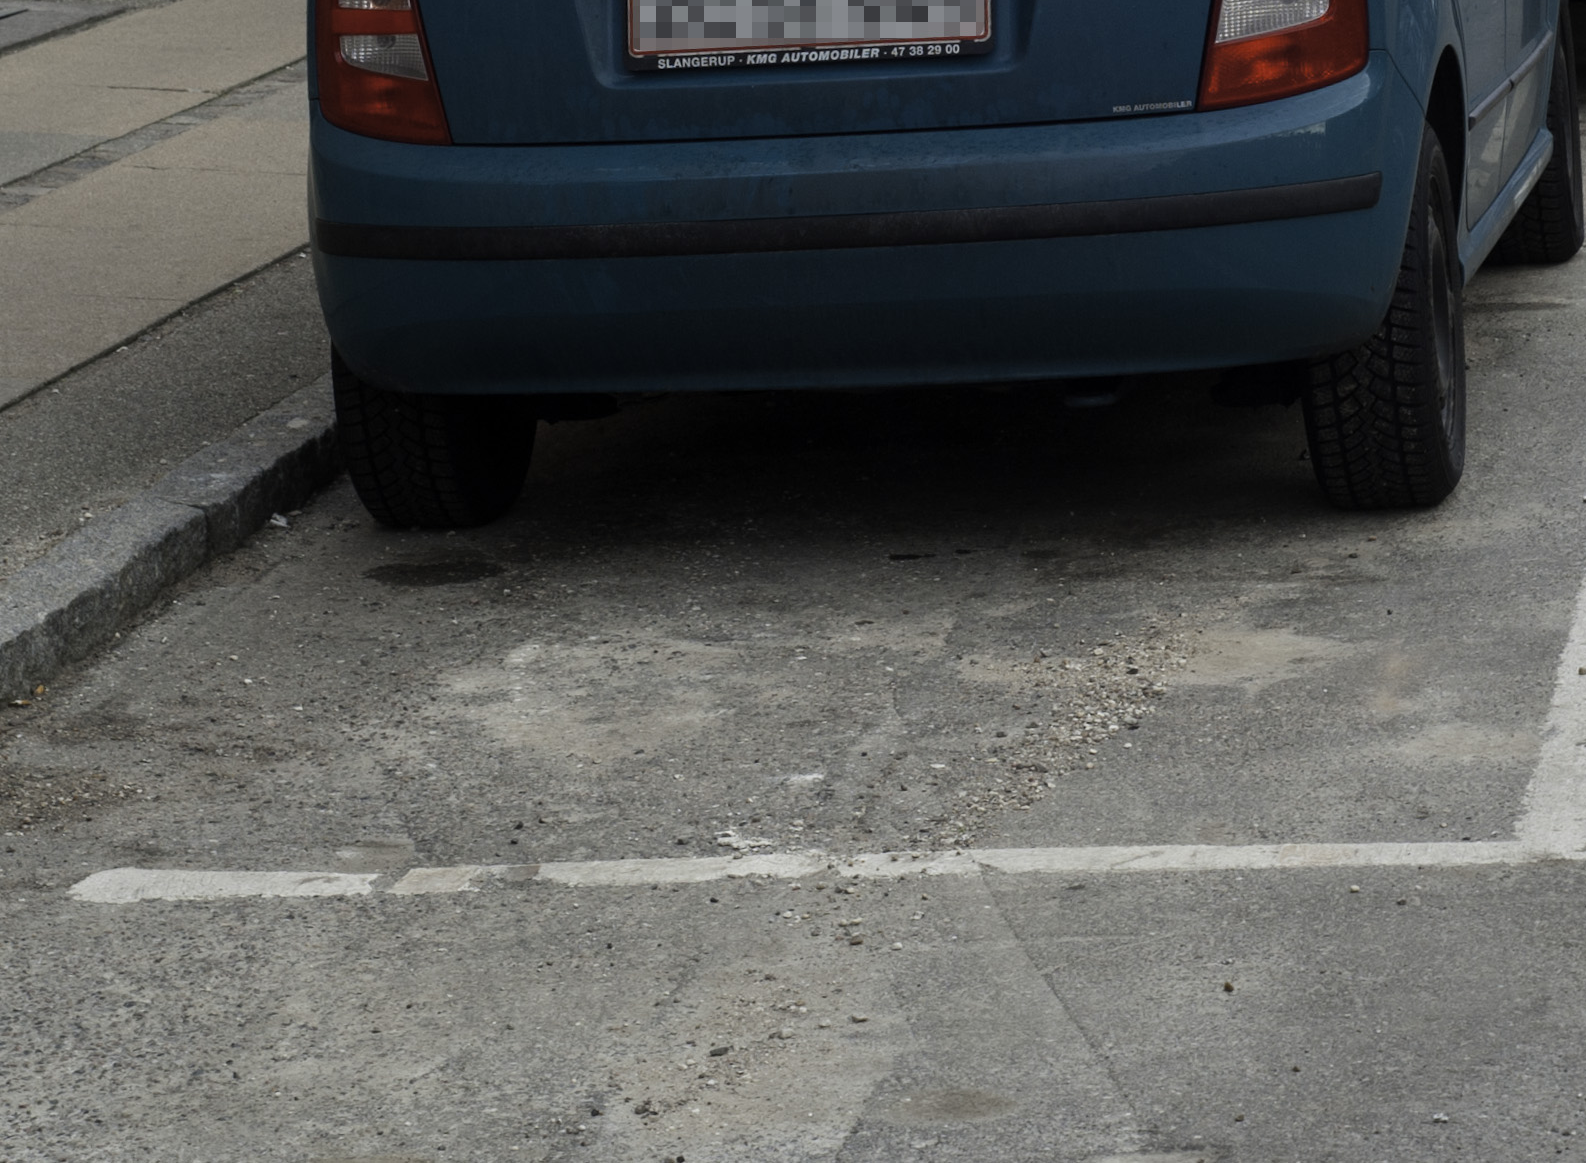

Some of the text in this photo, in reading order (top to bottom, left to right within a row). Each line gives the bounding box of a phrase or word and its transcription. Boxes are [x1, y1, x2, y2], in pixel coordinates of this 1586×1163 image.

[658, 43, 960, 70] SLANGERUP KMG AUTOMOBILER 47 38 29 00
